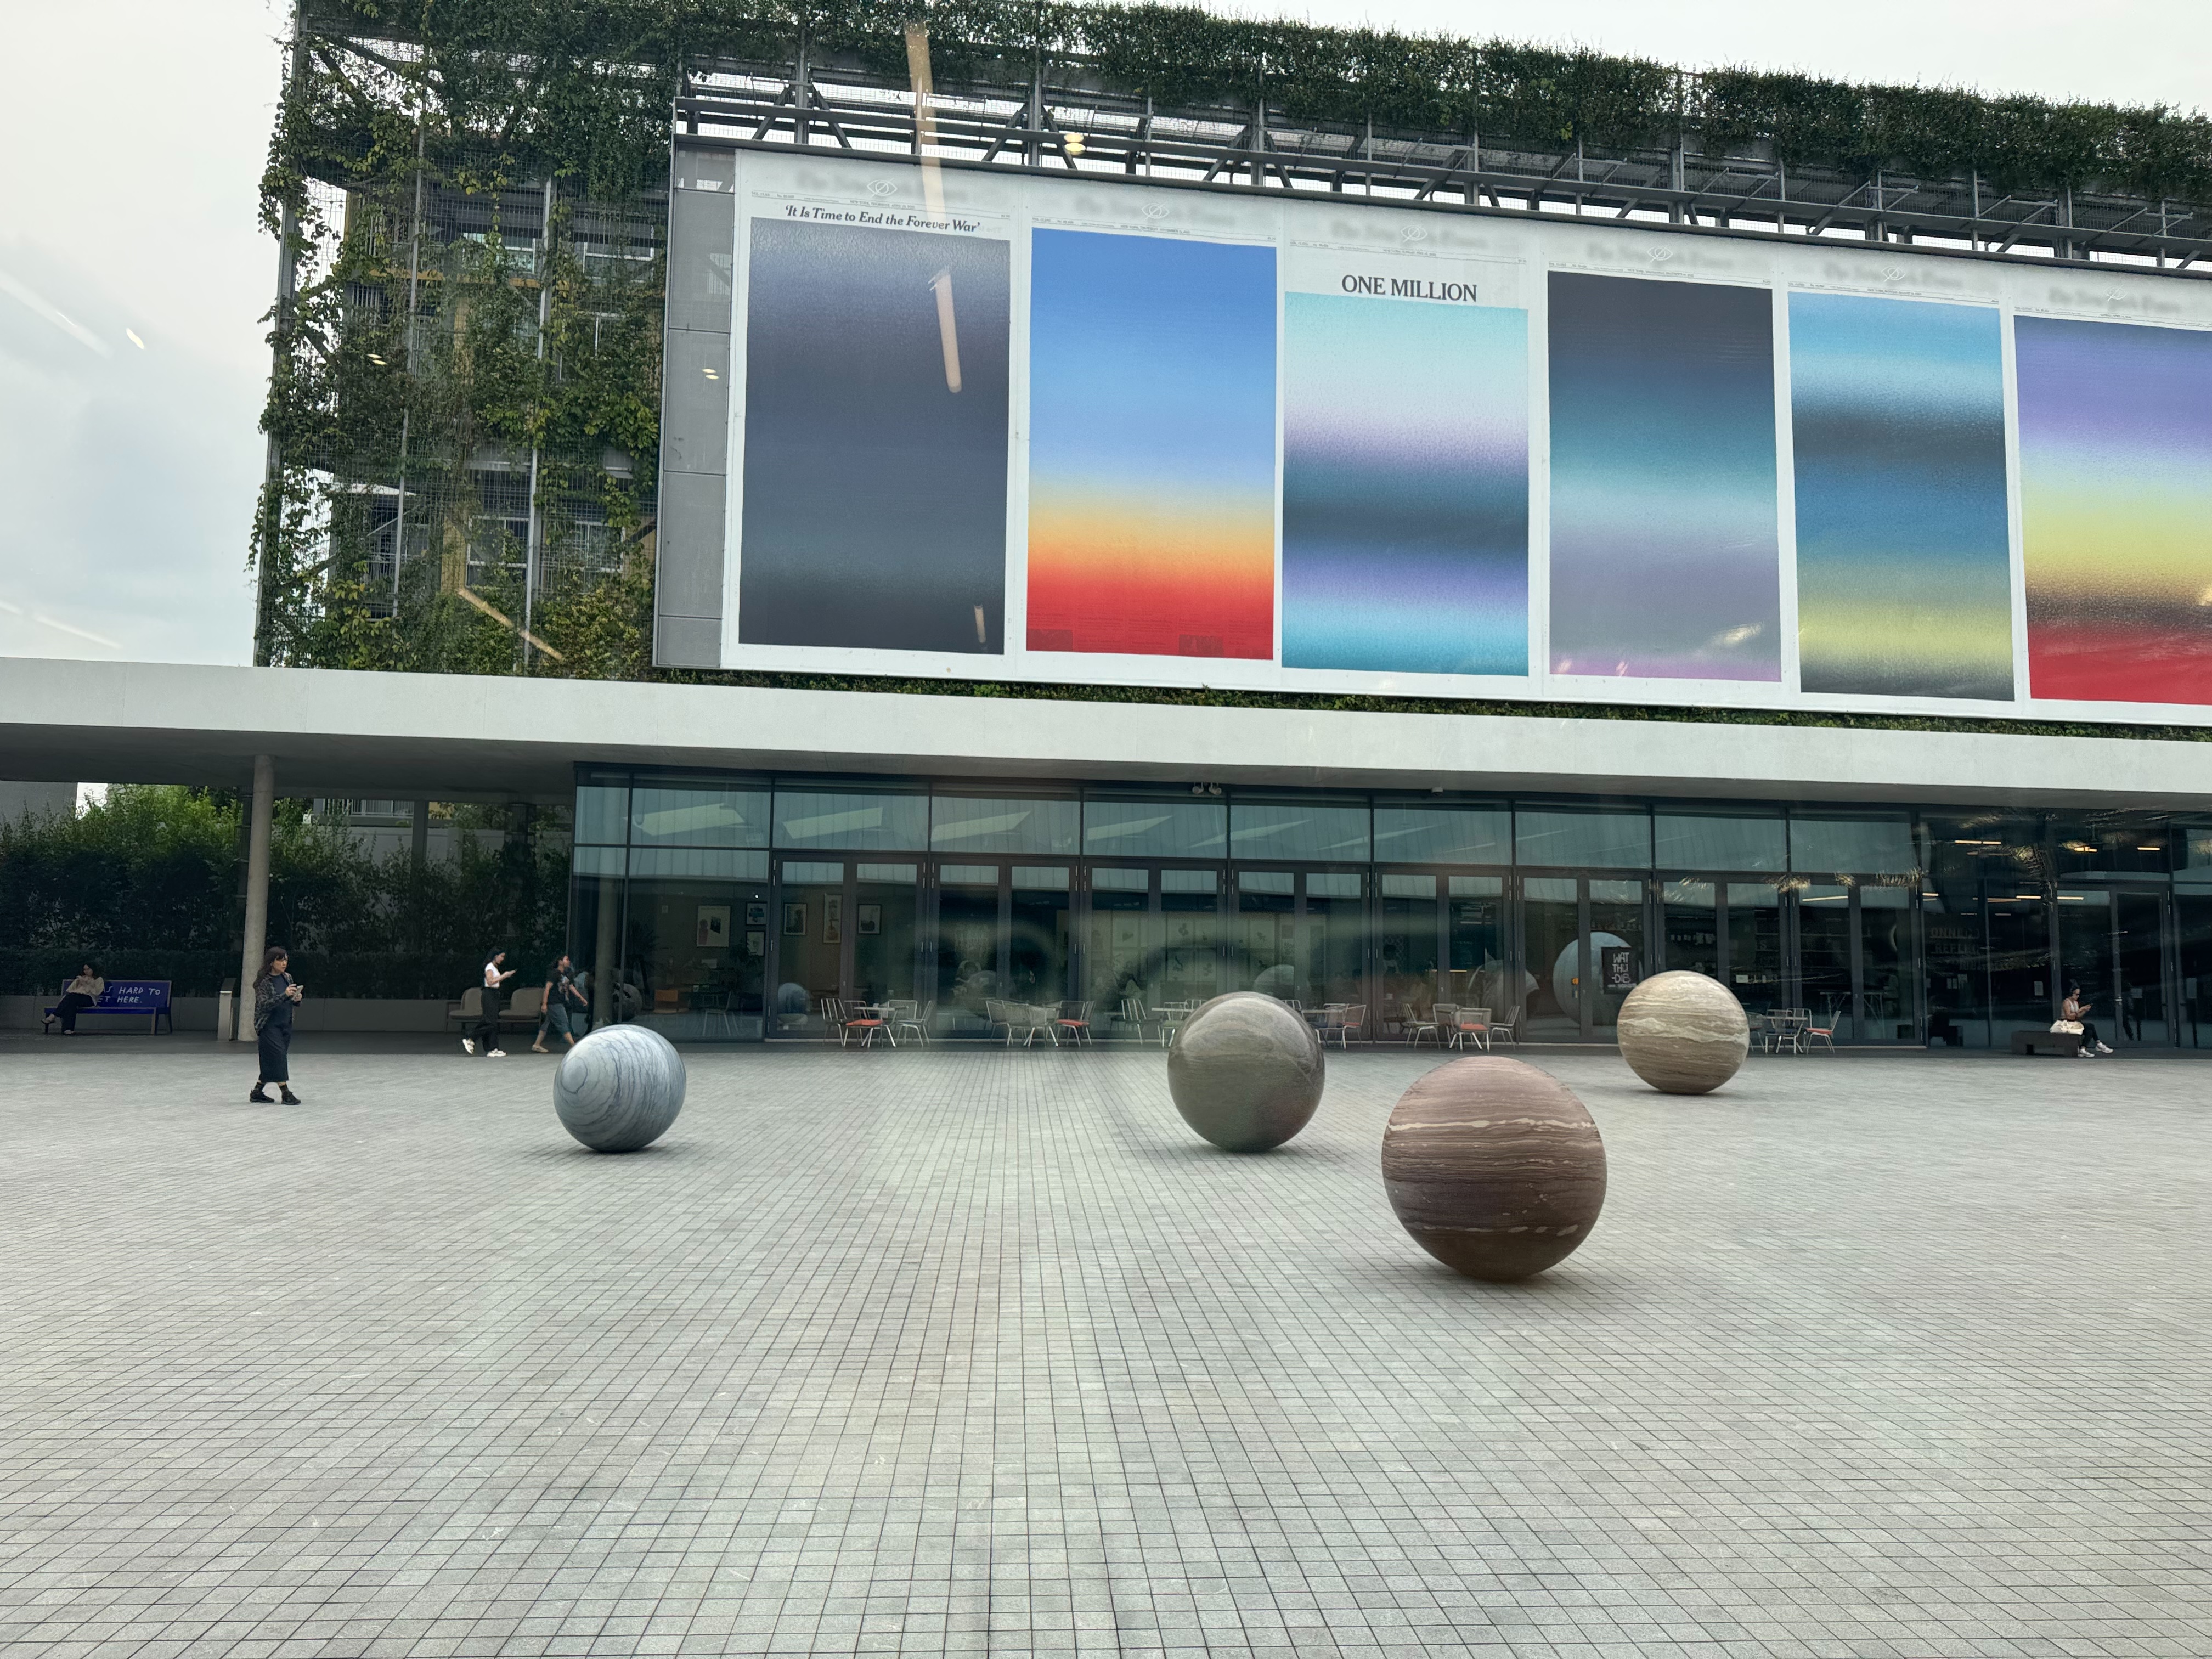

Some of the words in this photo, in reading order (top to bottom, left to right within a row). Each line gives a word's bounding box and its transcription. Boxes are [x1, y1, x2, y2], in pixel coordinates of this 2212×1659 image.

[799, 206, 810, 218] Is
[812, 207, 843, 221] Time
[844, 211, 856, 222] to
[858, 211, 883, 224] End
[885, 213, 904, 226] the
[906, 215, 951, 230] Forever
[1341, 274, 1386, 295] ONE
[1390, 278, 1478, 302] MILLION
[116, 995, 143, 1003] HERE.
[119, 986, 144, 995] HARD
[149, 988, 161, 996] TO
